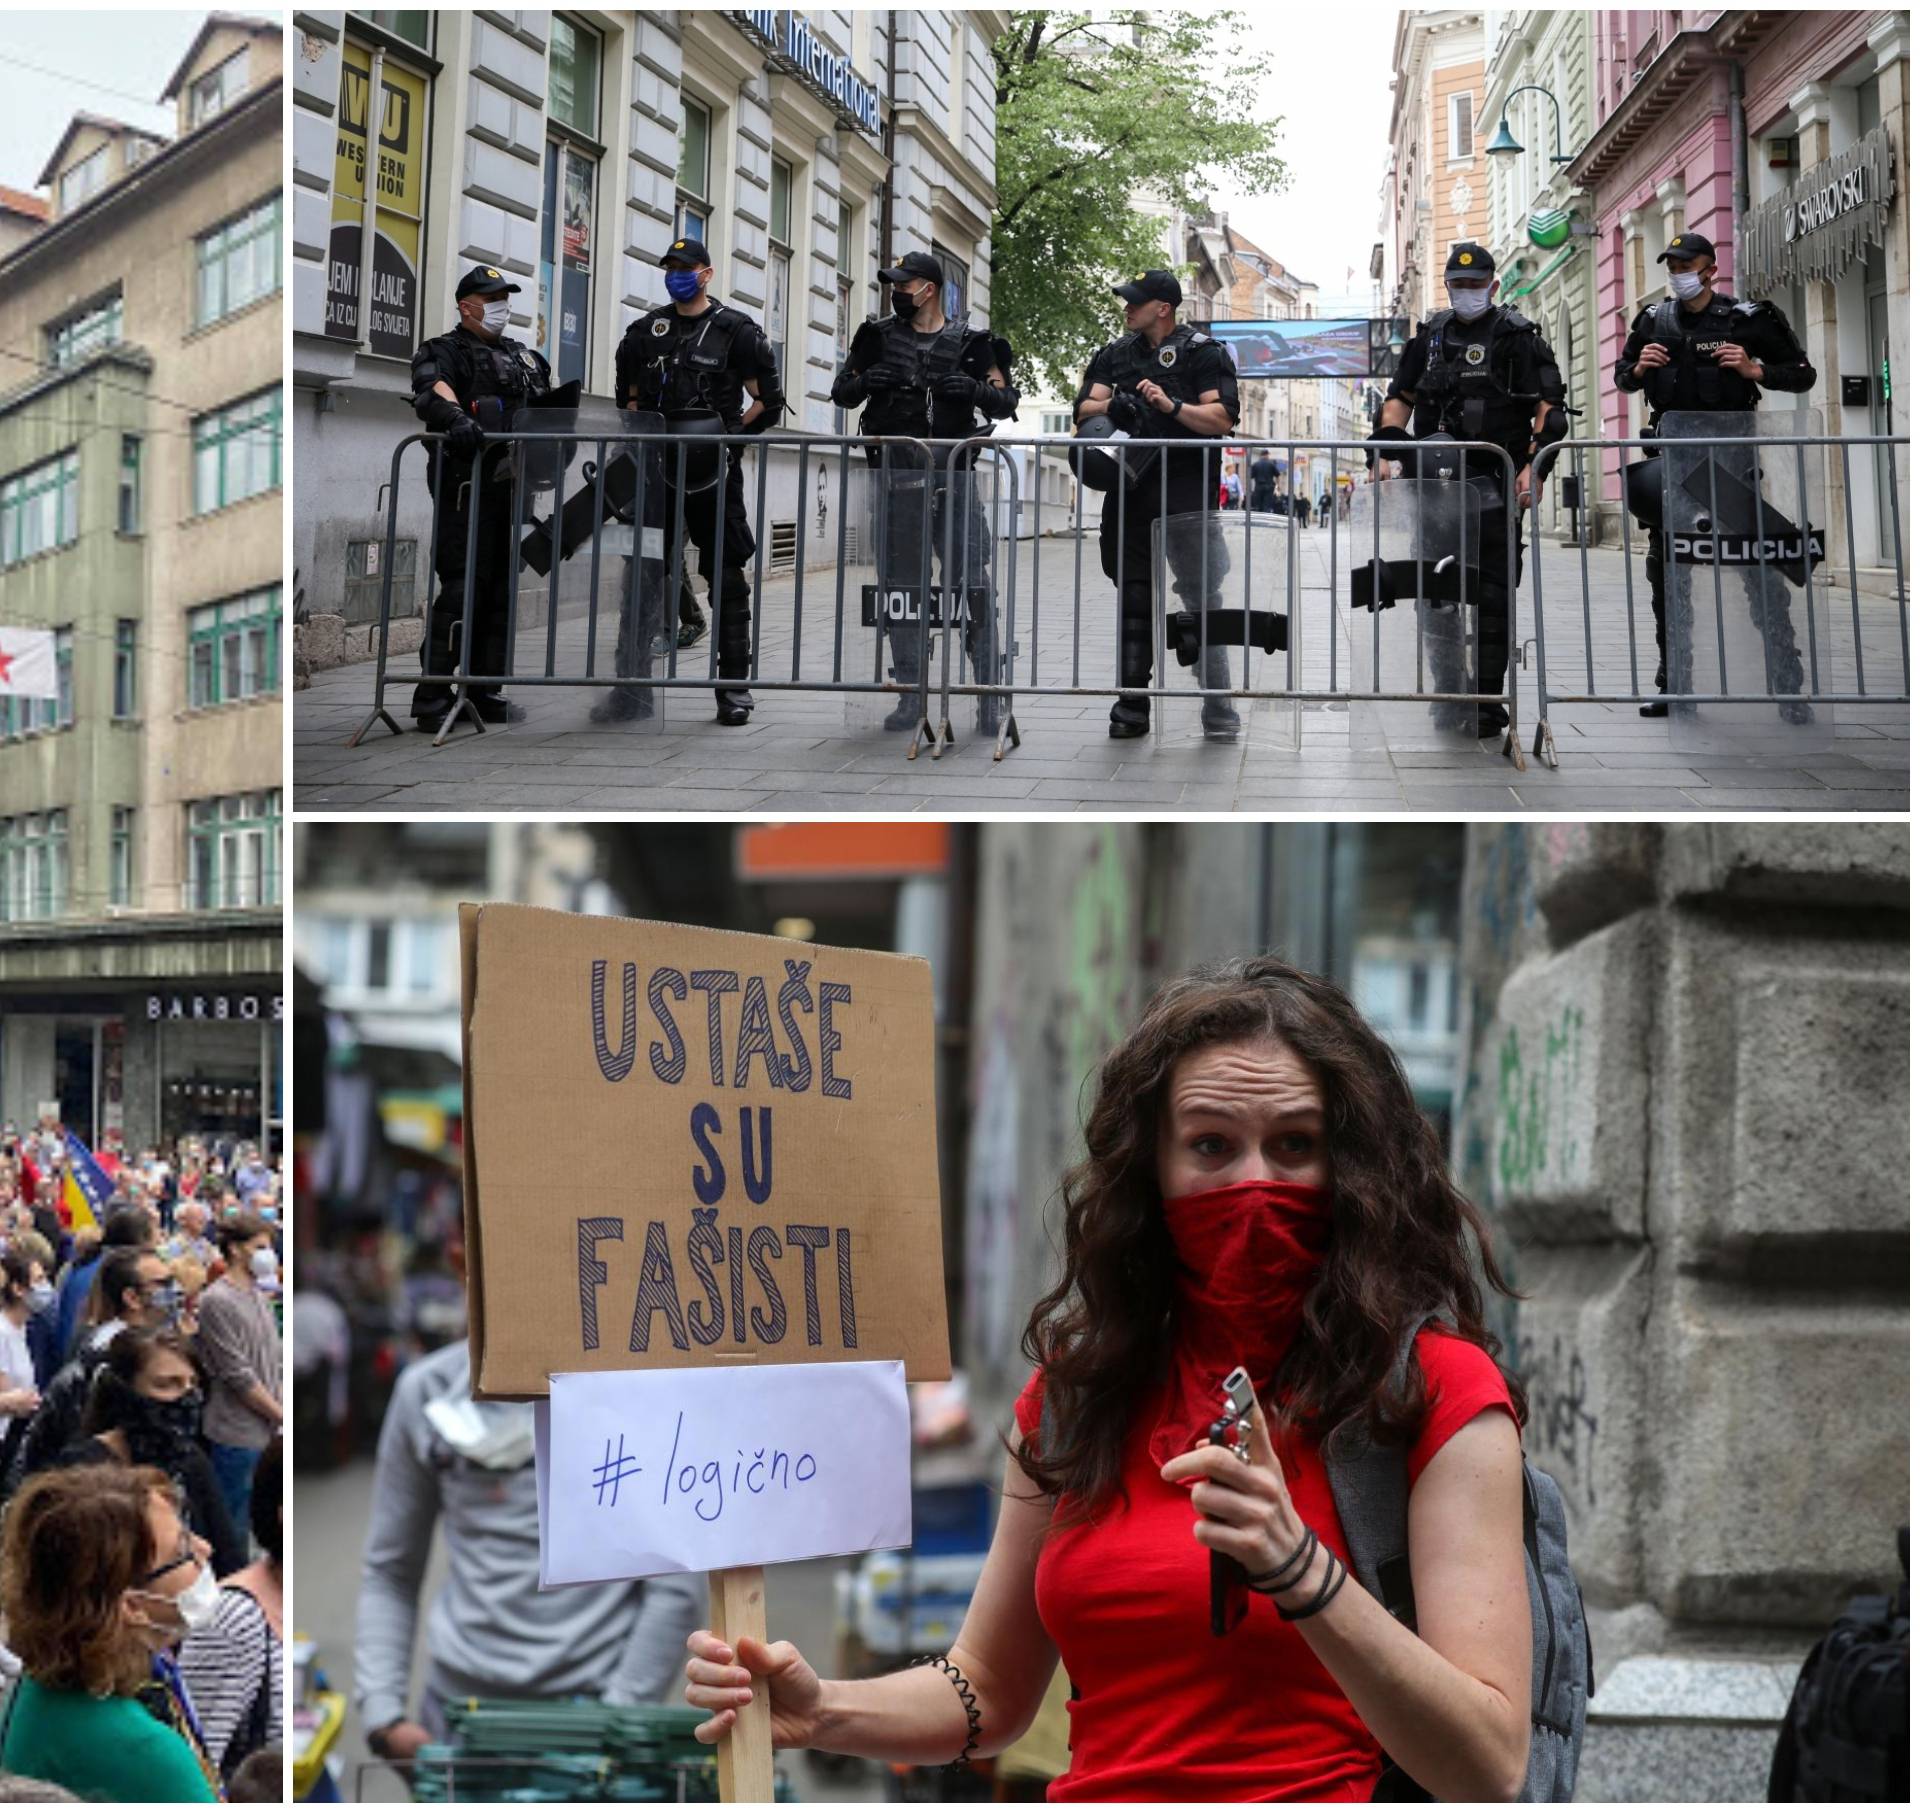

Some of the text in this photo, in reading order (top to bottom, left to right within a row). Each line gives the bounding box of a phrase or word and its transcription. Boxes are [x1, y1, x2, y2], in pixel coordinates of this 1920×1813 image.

[787, 10, 881, 136] International
[337, 138, 406, 180] WESERN
[1799, 166, 1865, 235] SWAROVSKI
[372, 270, 406, 308] LANJE
[336, 302, 345, 325] IZ
[383, 312, 410, 337] SVIJETA
[1672, 536, 1824, 561] POLICIJA
[874, 591, 972, 621] POLIJA
[146, 996, 283, 1019] BARBOS
[591, 959, 852, 1100] USTAŠE
[689, 1101, 773, 1205] SU
[577, 1208, 858, 1353] FAŠISTI
